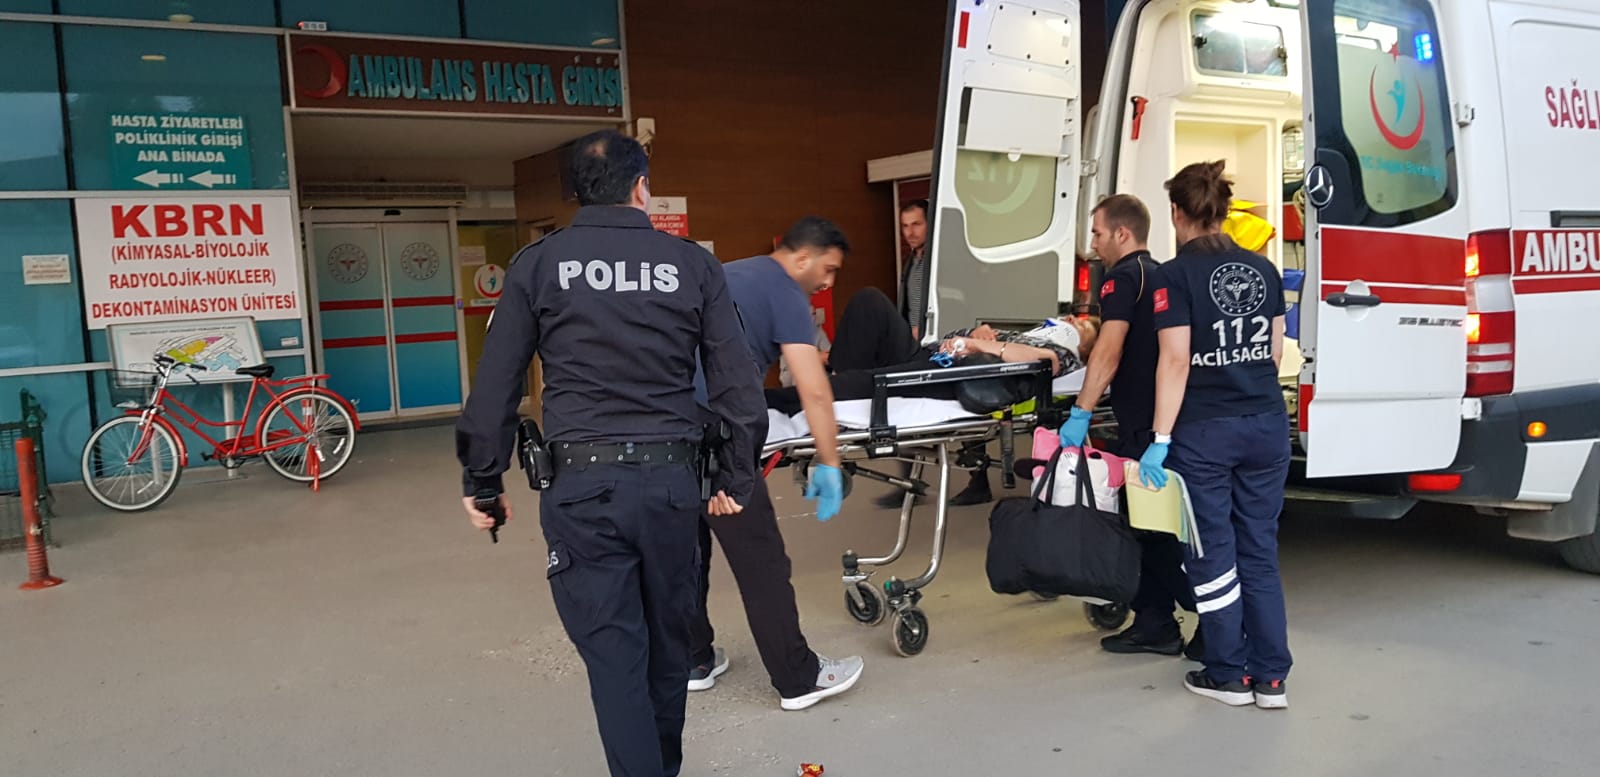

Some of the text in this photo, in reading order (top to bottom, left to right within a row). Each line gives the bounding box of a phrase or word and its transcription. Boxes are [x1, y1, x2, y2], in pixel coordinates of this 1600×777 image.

[348, 54, 477, 102] AMBULANS
[483, 61, 556, 104] HASTA
[111, 114, 243, 129] HASTA ZİYARETLERİ
[115, 130, 242, 149] POLİKLİNİK GİRİŞİ
[137, 147, 225, 162] ANA BİNADA
[111, 203, 264, 238] KBRN
[111, 239, 270, 264] (KİMYASAL-BİYOLOJİK
[1521, 231, 1600, 272] AMBU
[109, 267, 277, 289] RADYOLOJİK-NÜKLEER)
[92, 291, 296, 319] DEKONTAMİNASYON ÜNİTESİ
[1212, 315, 1270, 347] 112
[1191, 348, 1231, 367] ACİL
